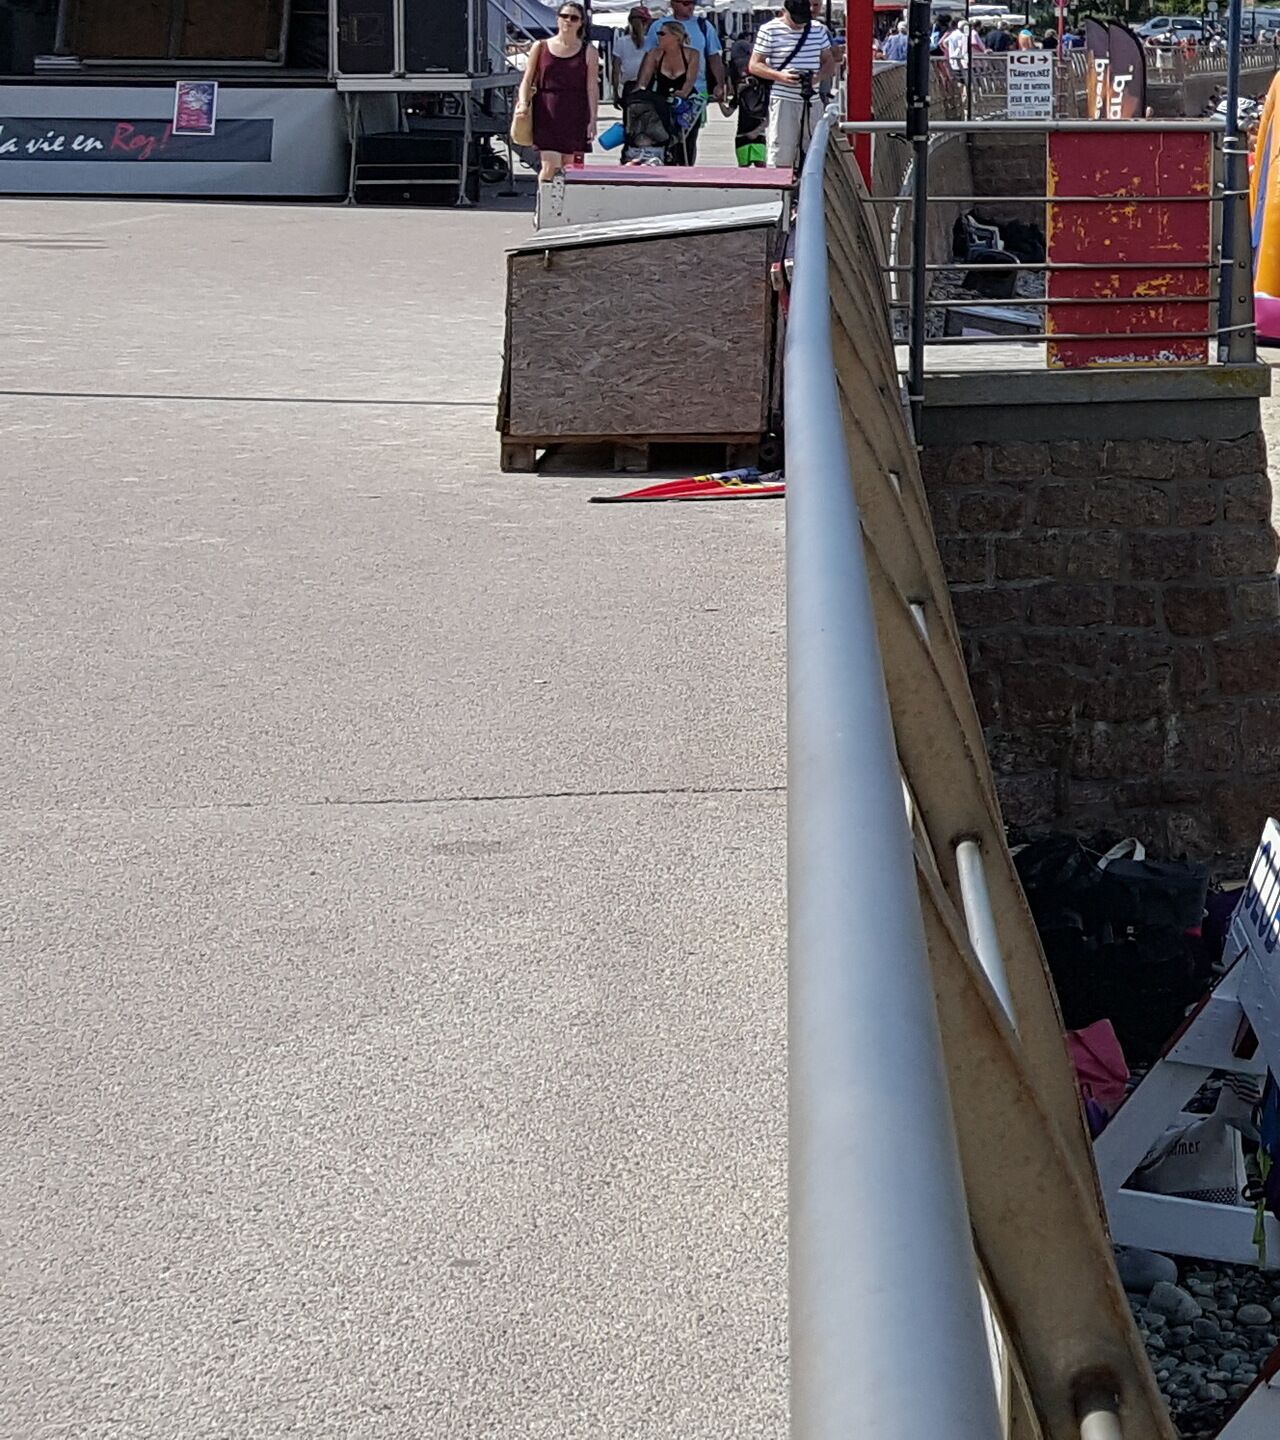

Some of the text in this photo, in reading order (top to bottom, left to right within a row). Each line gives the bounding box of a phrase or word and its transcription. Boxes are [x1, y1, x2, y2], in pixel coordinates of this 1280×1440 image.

[1010, 56, 1035, 64] ICI
[25, 130, 65, 154] vie
[71, 134, 104, 152] en
